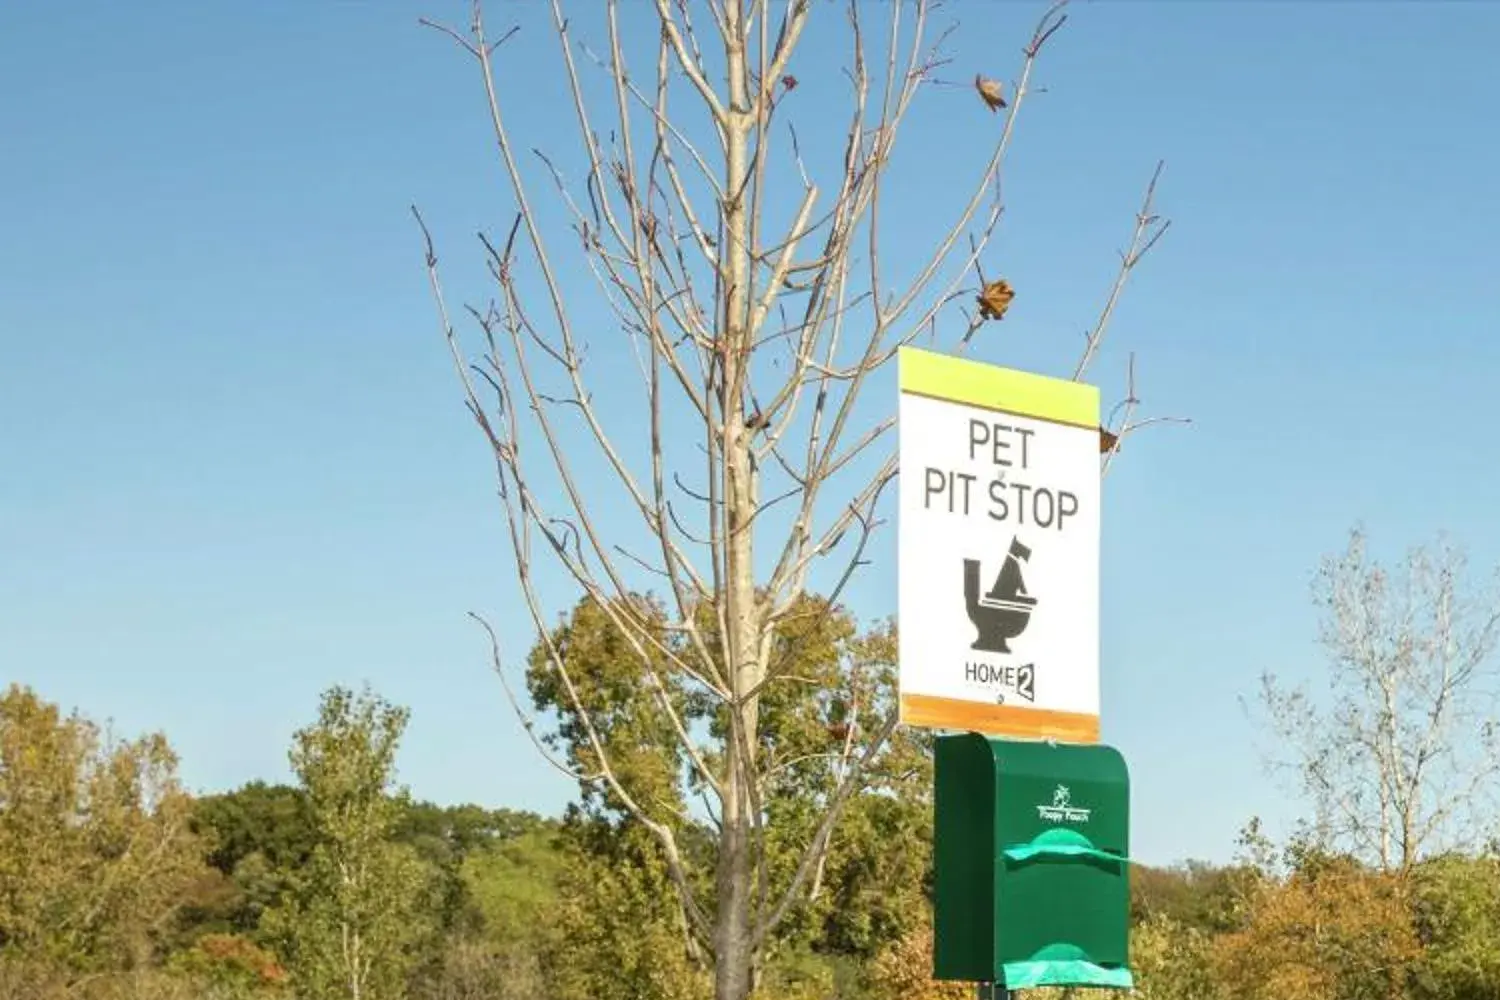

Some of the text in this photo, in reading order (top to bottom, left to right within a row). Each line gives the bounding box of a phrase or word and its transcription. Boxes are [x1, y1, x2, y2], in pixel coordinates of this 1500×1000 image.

[969, 418, 1035, 469] PET
[924, 466, 1079, 531] PIT STOP
